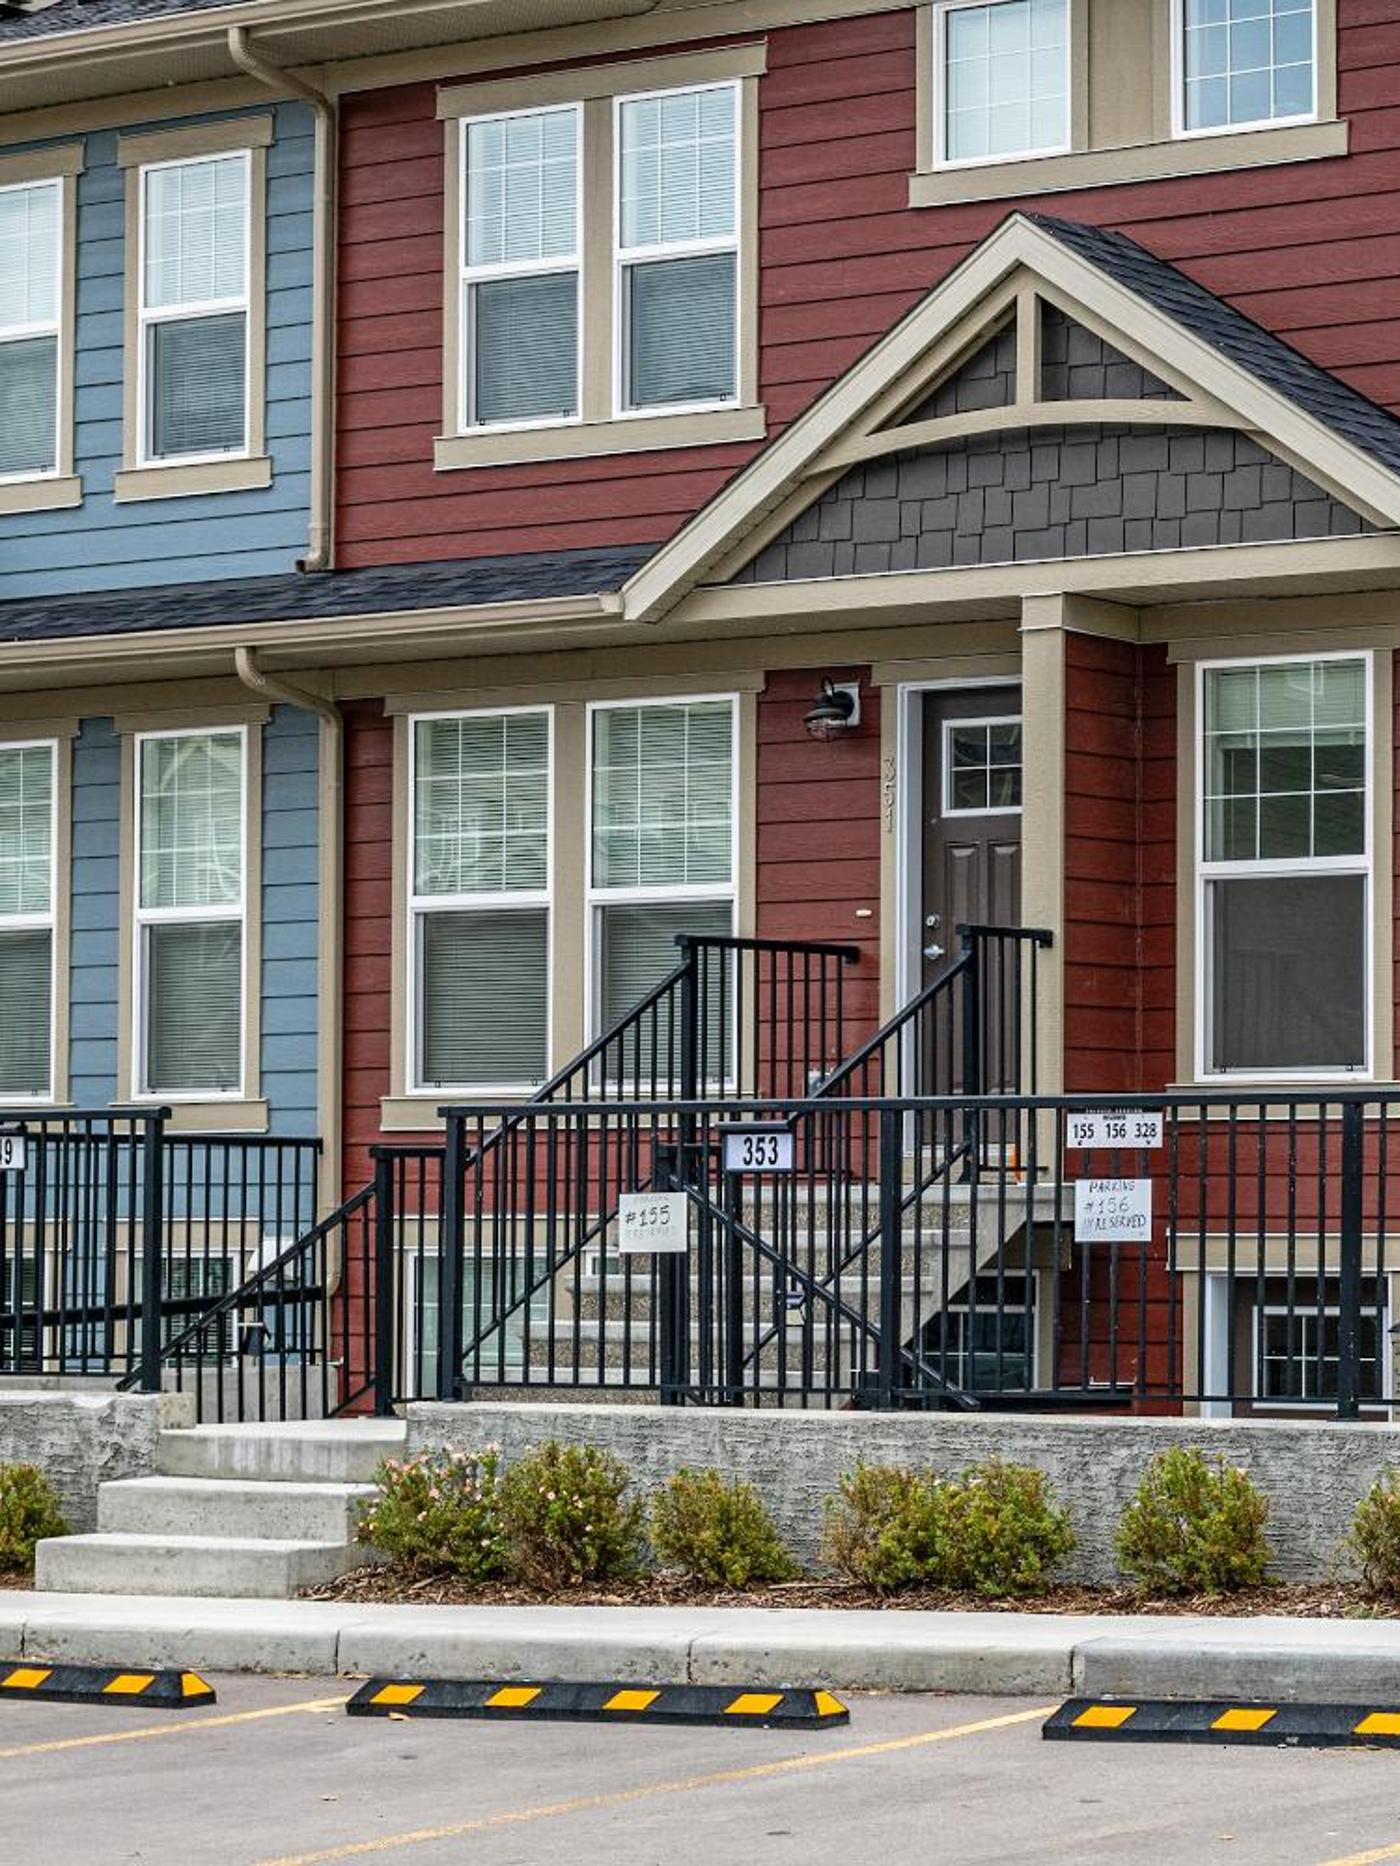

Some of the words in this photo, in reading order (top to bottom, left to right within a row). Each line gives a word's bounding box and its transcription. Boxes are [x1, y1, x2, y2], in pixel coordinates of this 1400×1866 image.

[883, 755, 896, 833] 351
[1073, 1123, 1094, 1139] 155
[1105, 1123, 1127, 1139] 156
[1134, 1123, 1158, 1139] 328
[0, 1138, 12, 1165] 9
[743, 1136, 778, 1166] 353
[1089, 1180, 1136, 1193] PARKING
[625, 1204, 671, 1227] #155
[1083, 1196, 1130, 1214] #156
